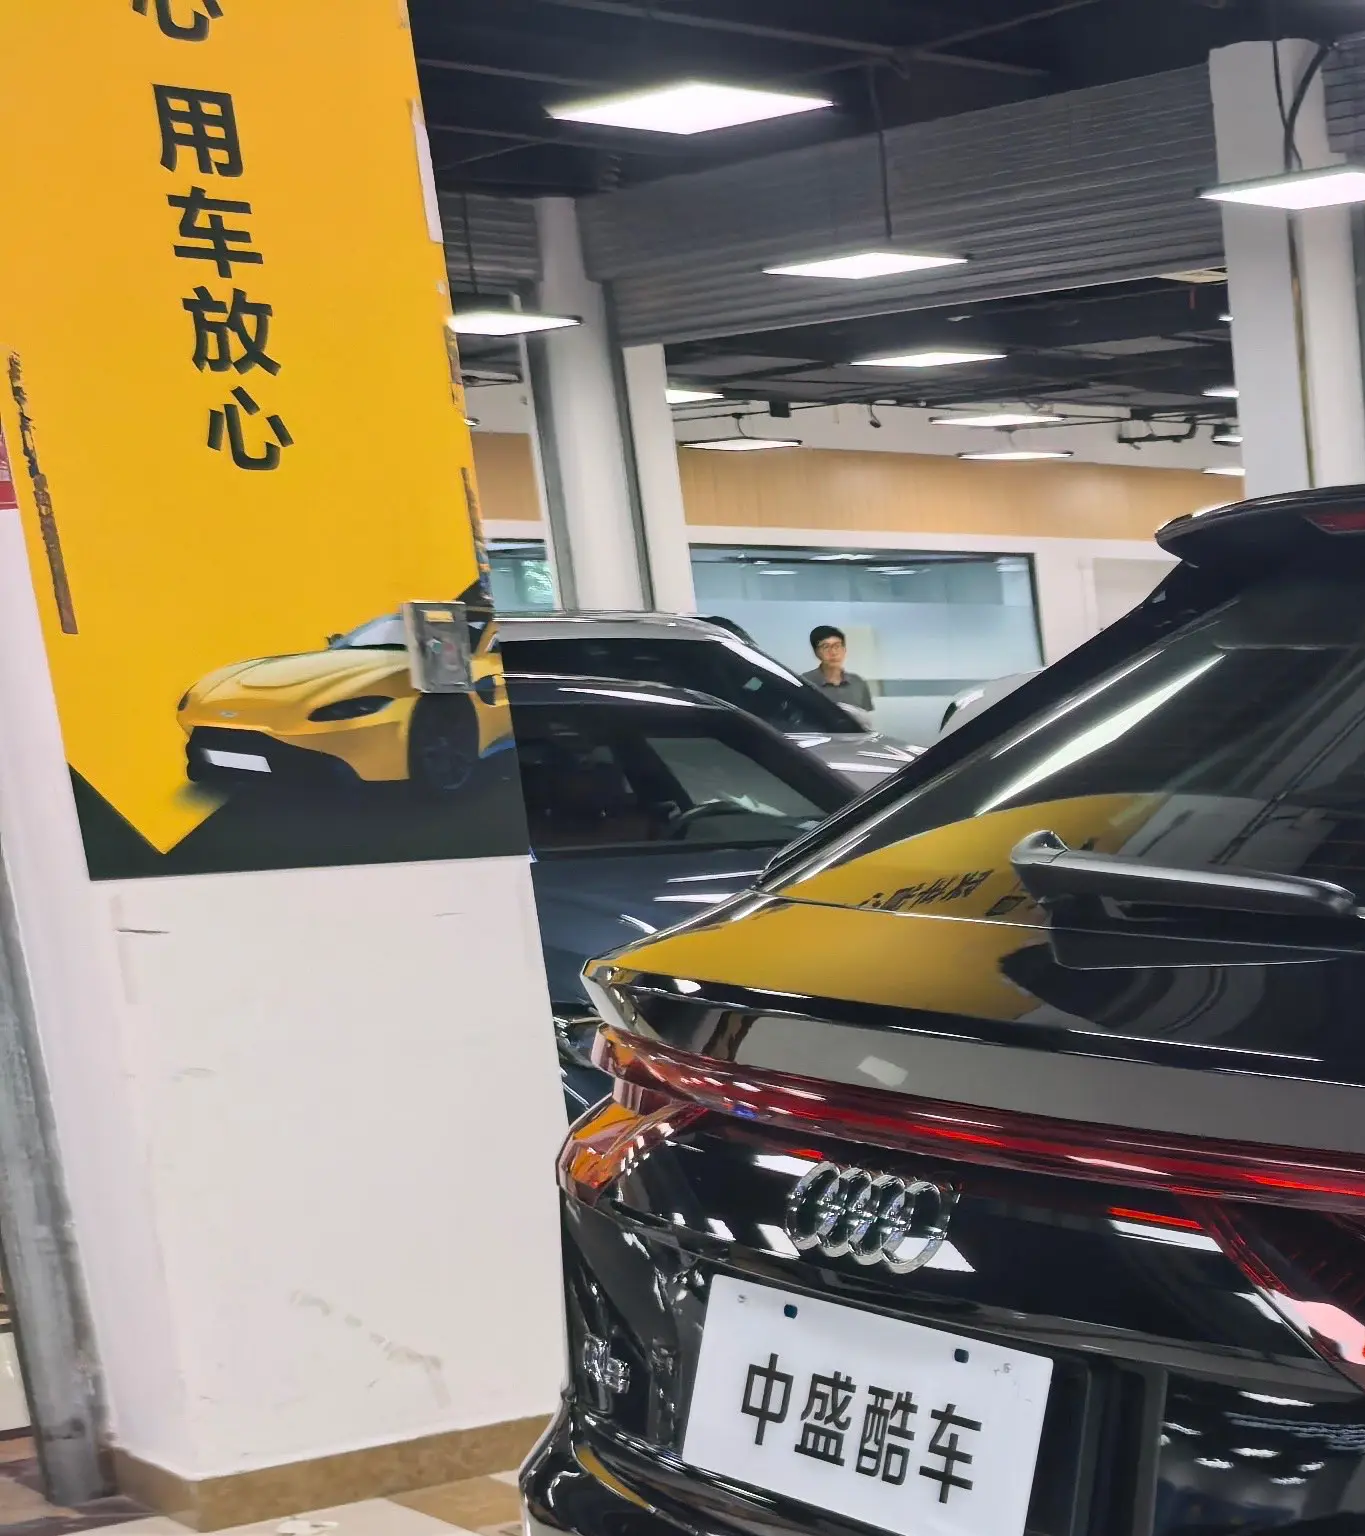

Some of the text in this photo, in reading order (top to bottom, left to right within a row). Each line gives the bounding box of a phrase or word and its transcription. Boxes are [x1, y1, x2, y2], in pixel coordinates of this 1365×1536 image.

[152, 83, 294, 470] 用车放心
[741, 1352, 982, 1504] 中盛酷车
